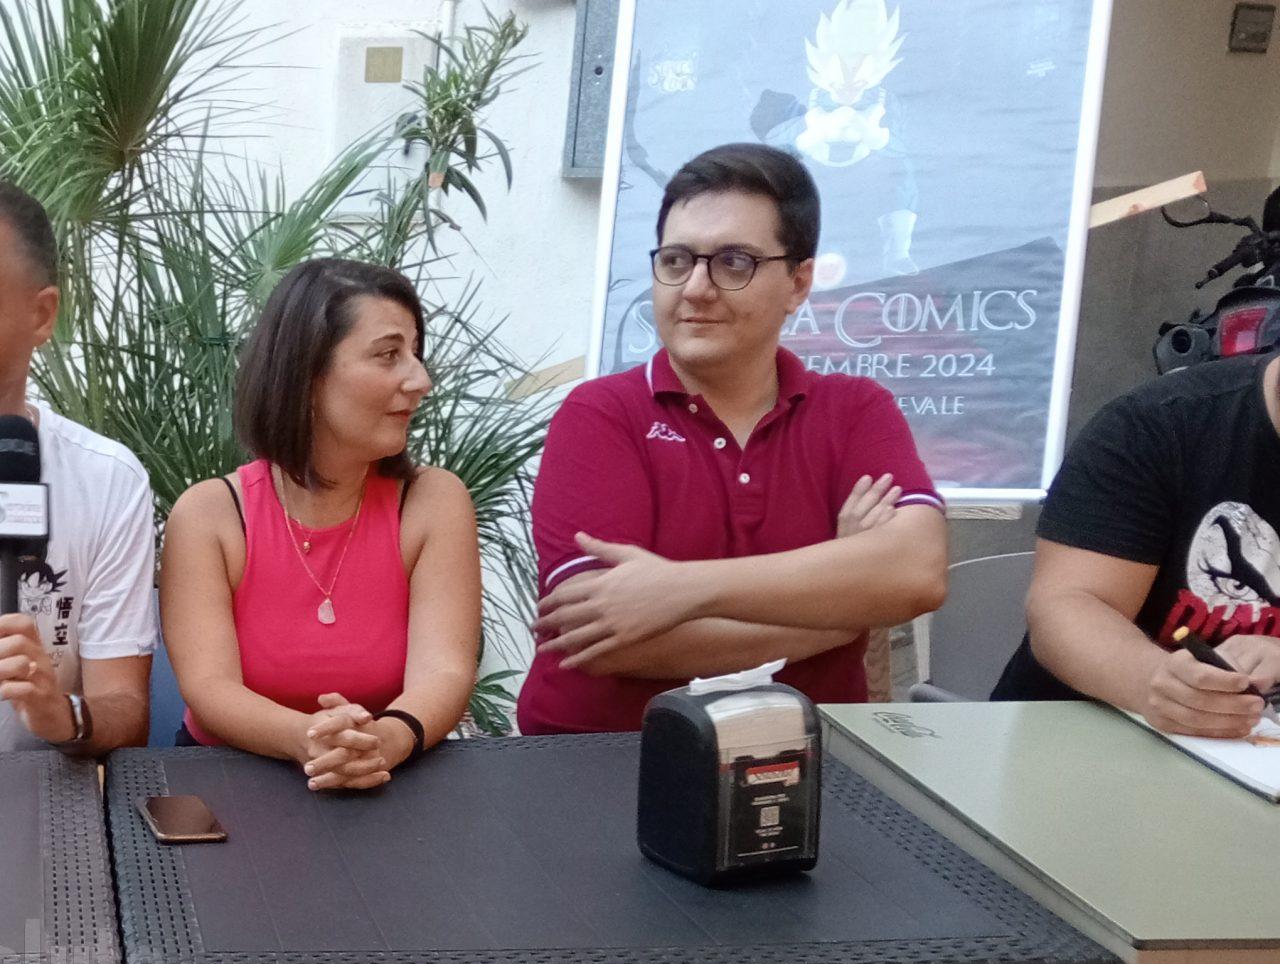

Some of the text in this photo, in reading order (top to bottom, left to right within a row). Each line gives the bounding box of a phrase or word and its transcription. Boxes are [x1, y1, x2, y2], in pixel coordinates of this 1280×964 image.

[834, 289, 1038, 348] COMICS
[920, 353, 996, 378] 2024
[898, 395, 965, 416] EVALE
